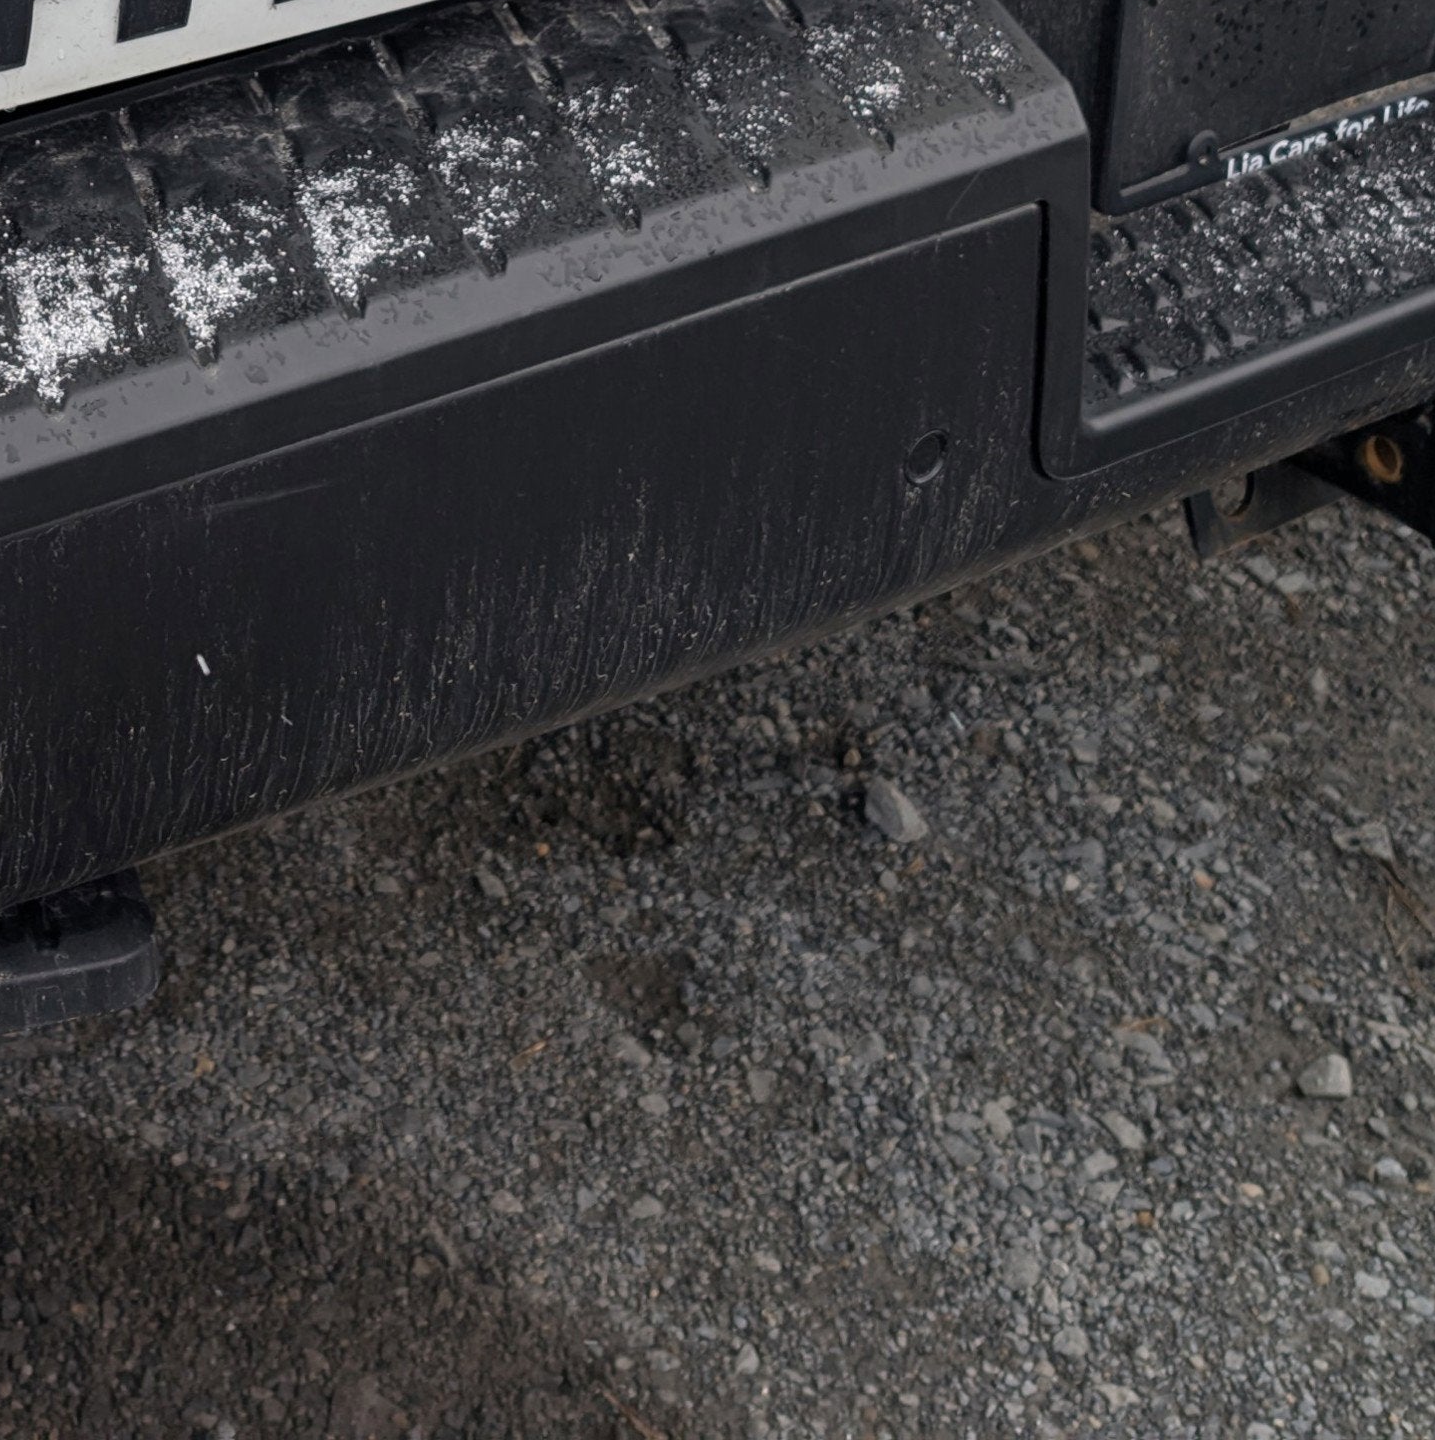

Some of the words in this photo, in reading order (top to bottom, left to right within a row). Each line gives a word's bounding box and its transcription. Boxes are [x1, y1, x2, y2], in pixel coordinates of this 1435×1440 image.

[1226, 152, 1264, 179] Lia
[1269, 132, 1329, 164] Cars
[1335, 116, 1376, 142] for
